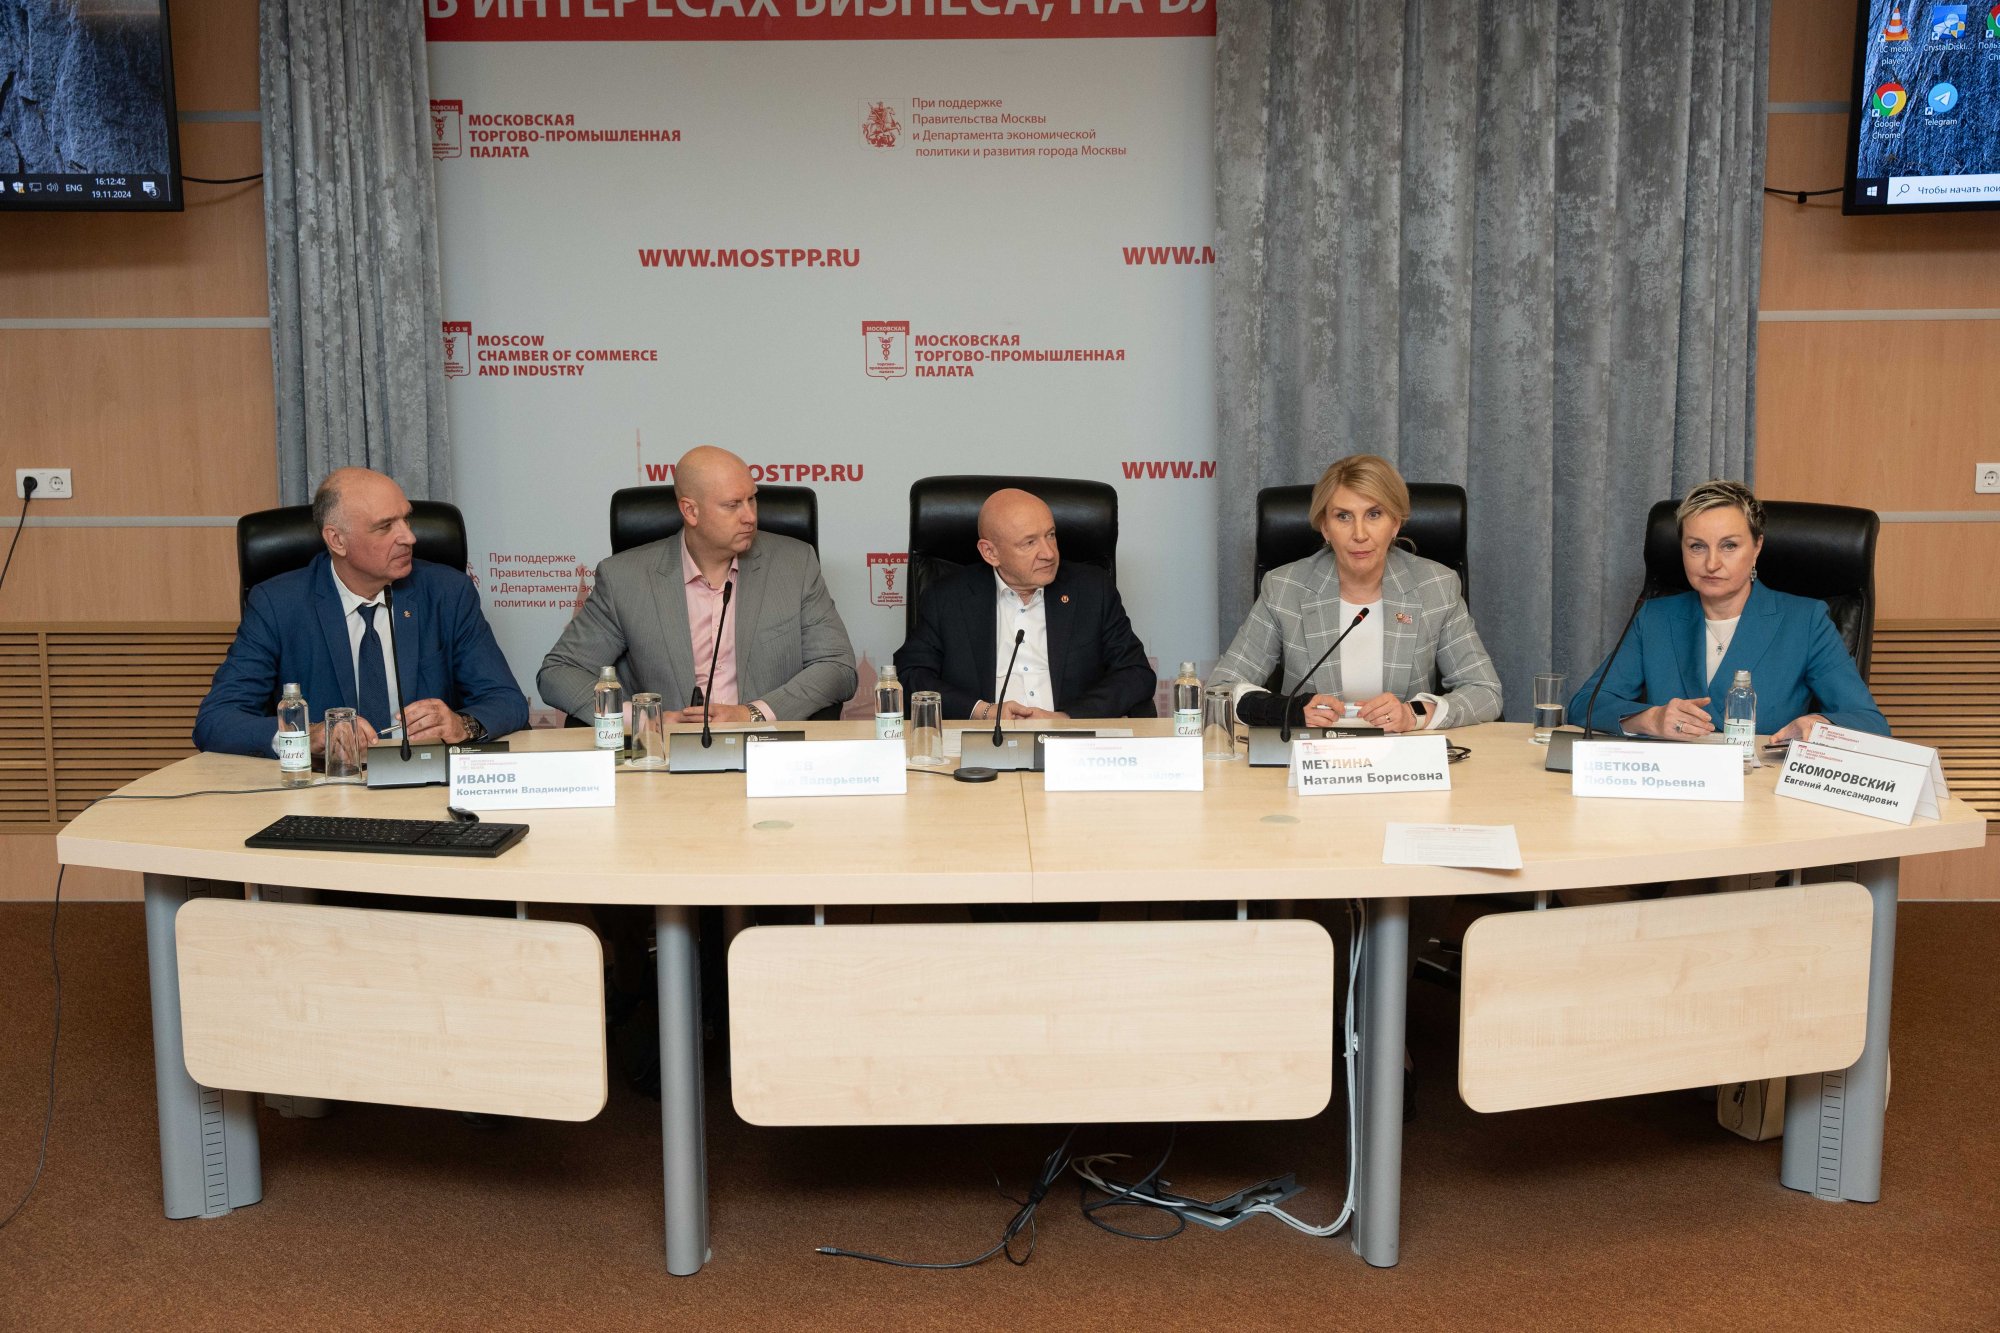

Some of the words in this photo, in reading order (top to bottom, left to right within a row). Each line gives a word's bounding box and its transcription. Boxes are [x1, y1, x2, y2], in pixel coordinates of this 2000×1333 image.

[912, 97, 935, 110] При
[938, 99, 1003, 110] поддержке
[468, 114, 575, 127] МОСКОВСКАЯ
[912, 113, 998, 126] Правительства
[1001, 113, 1047, 124] Москвы
[1874, 120, 1901, 128] Google
[1925, 118, 1958, 127] Telegram
[469, 130, 681, 142] ТОРГОВО-ПРОМЫШЛЕННАЯ
[912, 132, 920, 140] и
[922, 130, 1004, 142] Департамента
[1006, 129, 1096, 140] экономической
[1872, 131, 1901, 140] Chrome
[470, 146, 529, 158] ПАЛАТА
[916, 148, 970, 156] политики
[973, 148, 980, 156] и
[983, 147, 1035, 158] развития
[1038, 147, 1078, 158] города
[1081, 145, 1127, 156] Москвы
[65, 184, 83, 192] ENG
[95, 178, 126, 186] 16:12:42
[92, 190, 132, 199] 19.11.2024
[1918, 186, 1948, 195] Чтобы
[1950, 186, 1981, 194] начать
[1984, 185, 2000, 193] пои
[638, 248, 861, 268] WWW.MOSTPP.RU
[1122, 246, 1216, 265] WWW.M
[477, 335, 545, 347] MOSCOW
[914, 335, 1020, 347] МОСКОВСКАЯ
[477, 350, 549, 362] CHAMBER
[552, 350, 571, 361] OF
[575, 350, 658, 361] COMMERCE
[914, 349, 1125, 362] ТОРГОВО-ПРОМЫШЛЕННАЯ
[478, 365, 510, 377] AND
[513, 364, 585, 377] INDUSTRY
[915, 365, 975, 378] ПАЛАТА
[645, 464, 864, 482] WOSTPP.RU
[1121, 461, 1216, 479] WWW.M
[489, 552, 511, 564] При
[514, 554, 576, 564] поддержке
[490, 567, 572, 579] Правительства
[575, 567, 598, 578] Мос
[490, 585, 498, 593] и
[500, 582, 578, 594] Департамента
[494, 600, 546, 608] политики
[549, 600, 556, 608] и
[558, 600, 584, 609] разв
[1302, 757, 1373, 770] МЕТЛИНА
[1584, 761, 1661, 773] ЦВЕТКОВА
[456, 773, 516, 785] ИВАНОВ
[1303, 775, 1363, 786] Наталия
[1367, 772, 1443, 785] Борисовна
[1642, 776, 1706, 789] Юрьевна
[1789, 761, 1896, 793] СКОМОРОВСКИЙ
[456, 788, 518, 797] Константин
[521, 786, 600, 796] Владимирович
[1784, 775, 1822, 790] Евгений
[1823, 784, 1899, 808] Александрович
